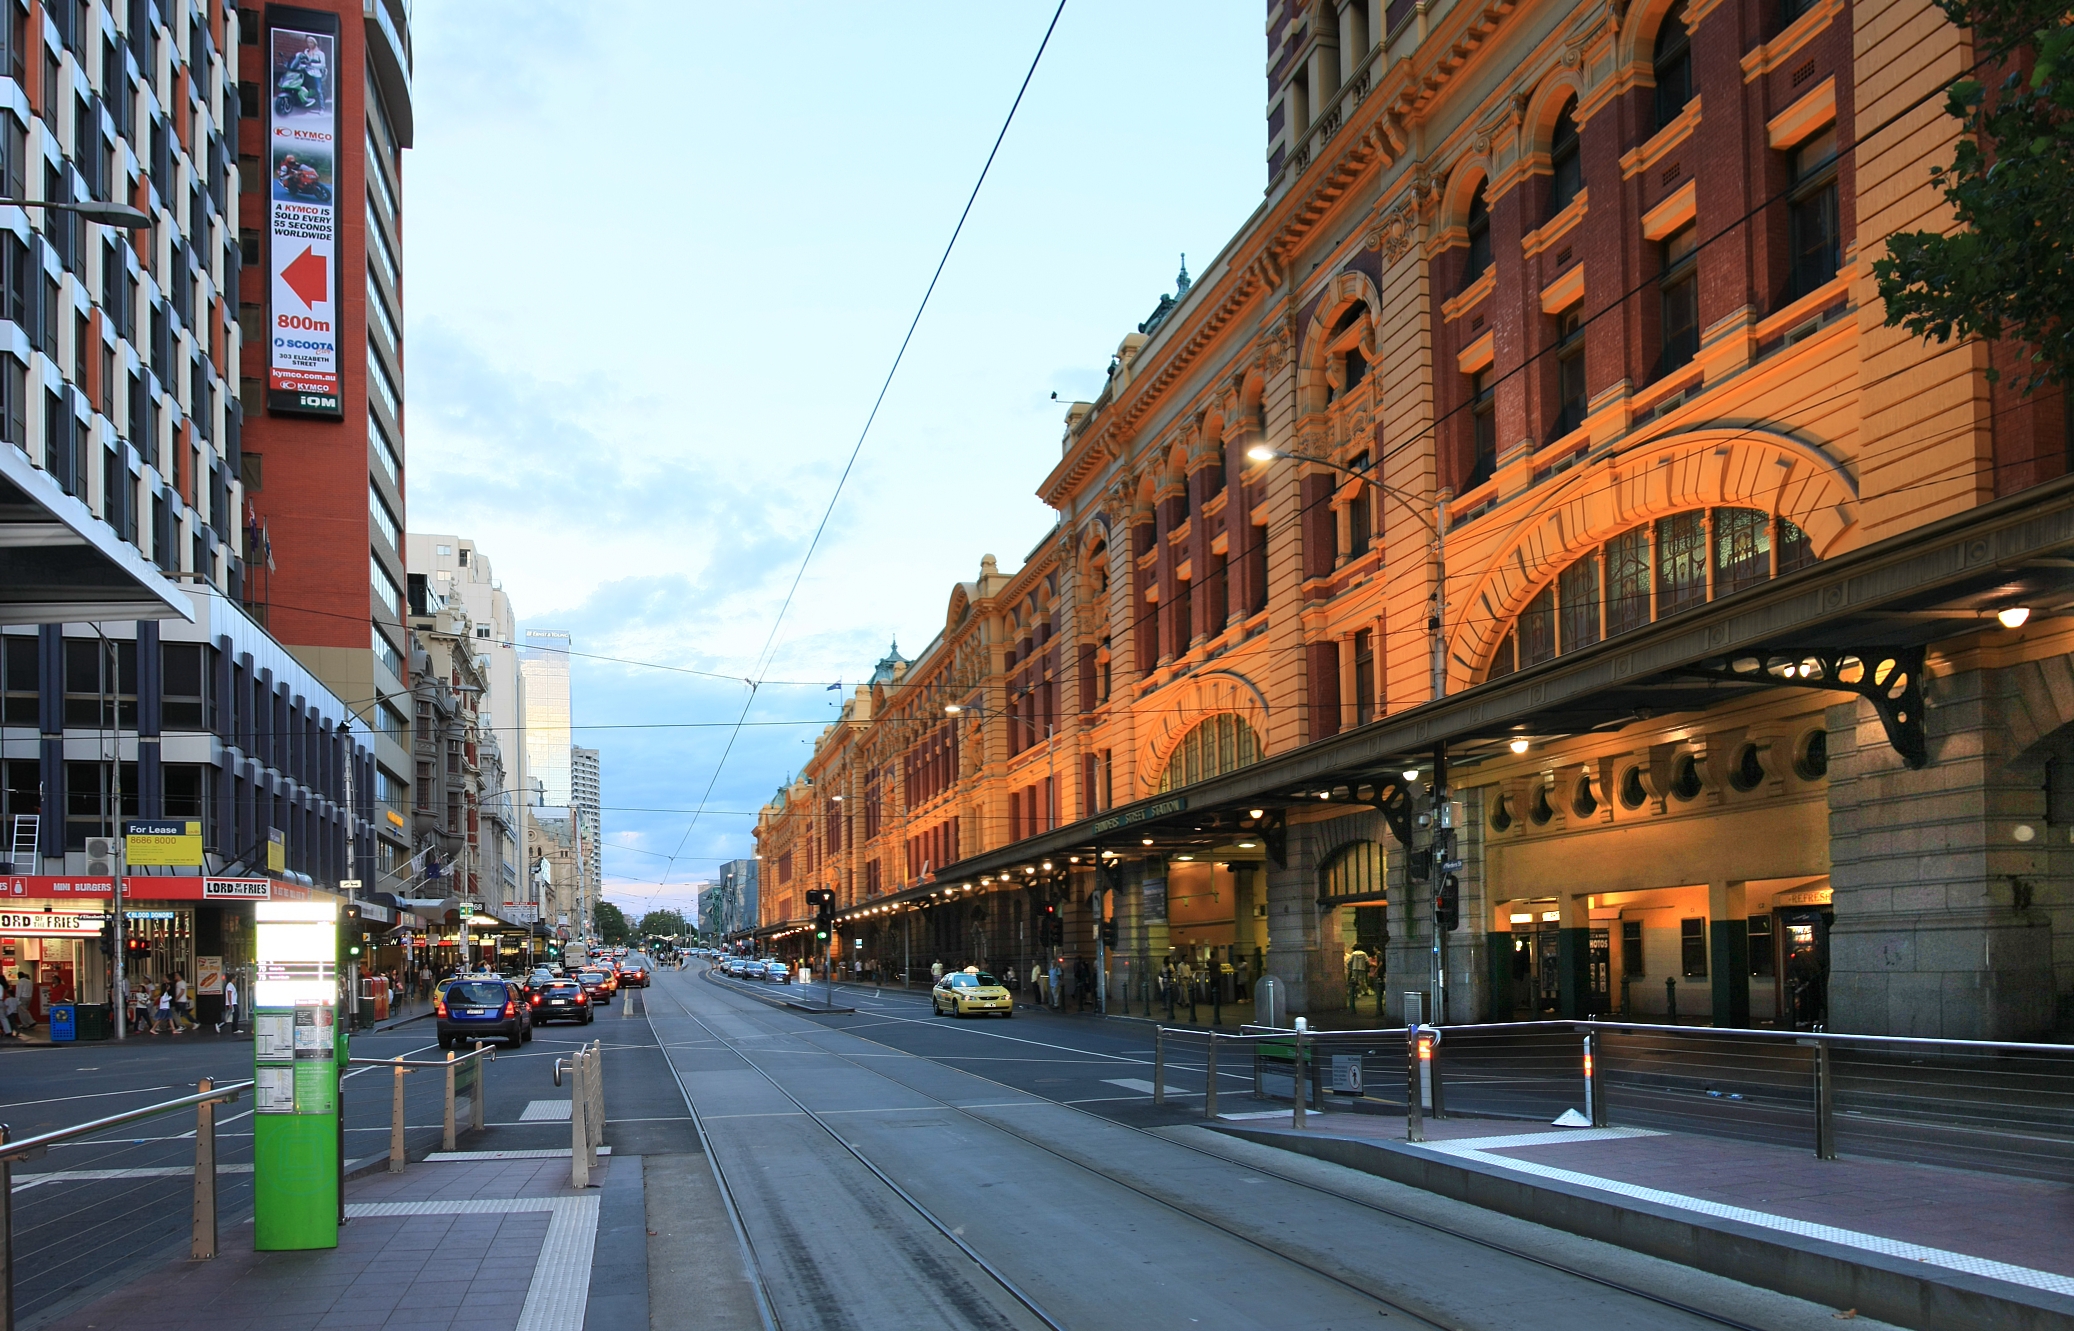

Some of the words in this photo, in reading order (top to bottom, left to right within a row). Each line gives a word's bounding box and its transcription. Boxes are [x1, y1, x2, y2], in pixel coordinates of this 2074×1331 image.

[294, 130, 332, 140] KYMCO
[285, 205, 318, 214] KYMCO
[274, 212, 300, 220] SOLD
[302, 214, 332, 224] EVERY
[288, 222, 332, 232] SECONDS
[274, 228, 332, 240] WORLDWIDE
[278, 314, 330, 332] 800m
[286, 339, 334, 352] SCOOTA
[294, 354, 330, 362] ELIZABETH
[272, 369, 336, 381] kymco.com.au
[297, 382, 330, 392] KYMCO
[1126, 809, 1146, 824] STREET
[1151, 799, 1180, 816] STATION
[130, 826, 146, 834] For
[148, 826, 177, 834] Lease
[154, 836, 176, 844] 8000
[53, 882, 70, 891] MINI
[74, 883, 112, 892] BURGERS
[207, 882, 234, 893] LORD
[244, 884, 266, 894] FRIES
[1791, 892, 1831, 904] REFRESH
[2, 915, 31, 928] ORD
[47, 916, 80, 928] FRIES
[1590, 940, 1608, 948] HOTOS
